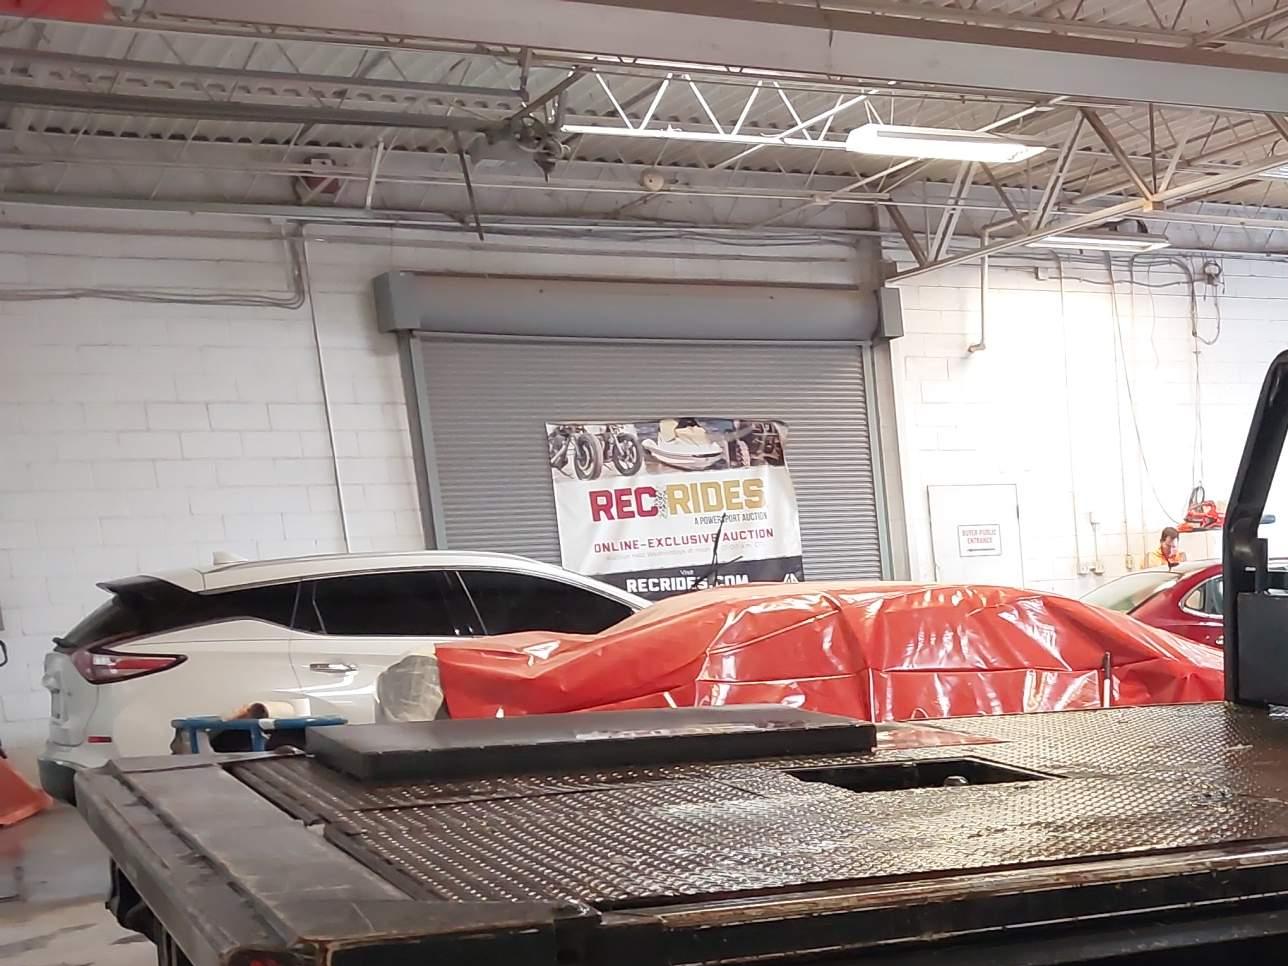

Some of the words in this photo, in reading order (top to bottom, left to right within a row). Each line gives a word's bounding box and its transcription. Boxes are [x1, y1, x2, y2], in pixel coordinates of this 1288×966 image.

[588, 486, 659, 522] REC
[665, 478, 765, 516] RIDES
[699, 514, 741, 525] POWERPORT
[742, 512, 768, 522] AUCTION
[722, 527, 775, 542] AUCTION
